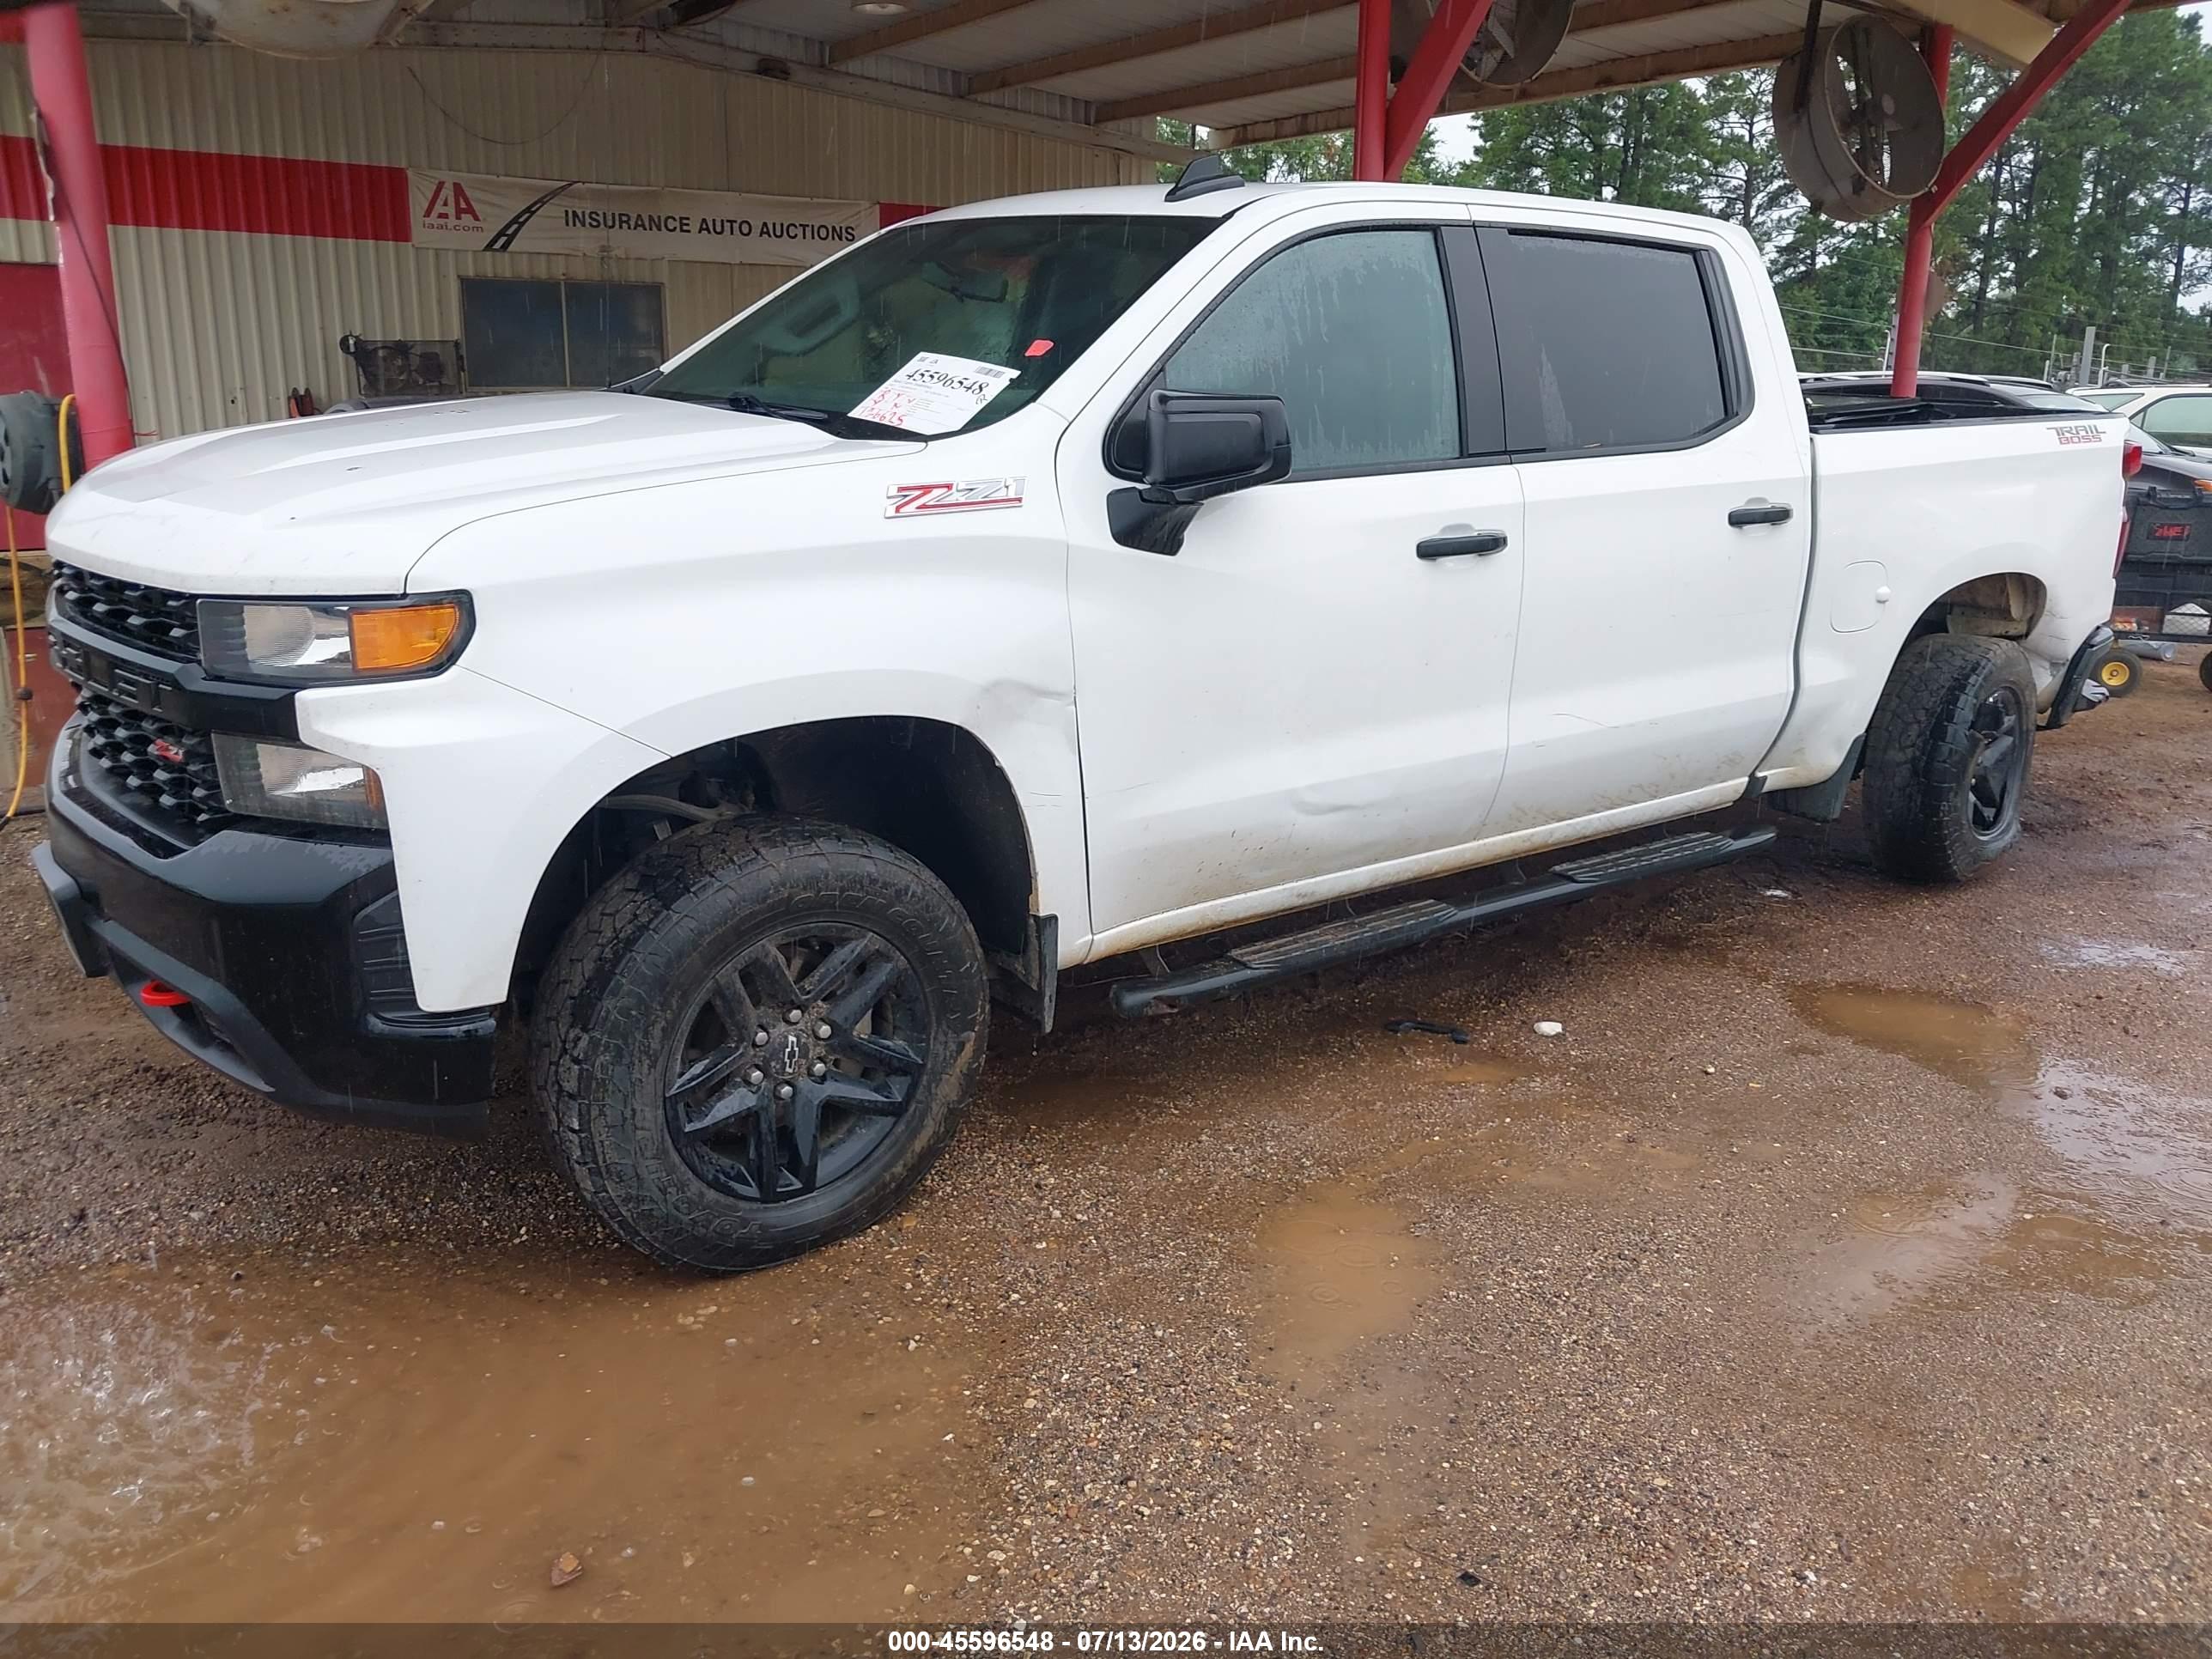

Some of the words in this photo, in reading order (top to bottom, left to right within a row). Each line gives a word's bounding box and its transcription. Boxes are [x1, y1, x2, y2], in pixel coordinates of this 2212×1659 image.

[422, 220, 484, 233] iaai.com
[563, 209, 692, 234] INSURANCE
[697, 217, 753, 237] AUTO
[758, 221, 856, 242] AUCTIONS
[906, 368, 989, 396] 45596548
[2045, 424, 2107, 437] TRAIL
[2057, 434, 2103, 446] BOSS
